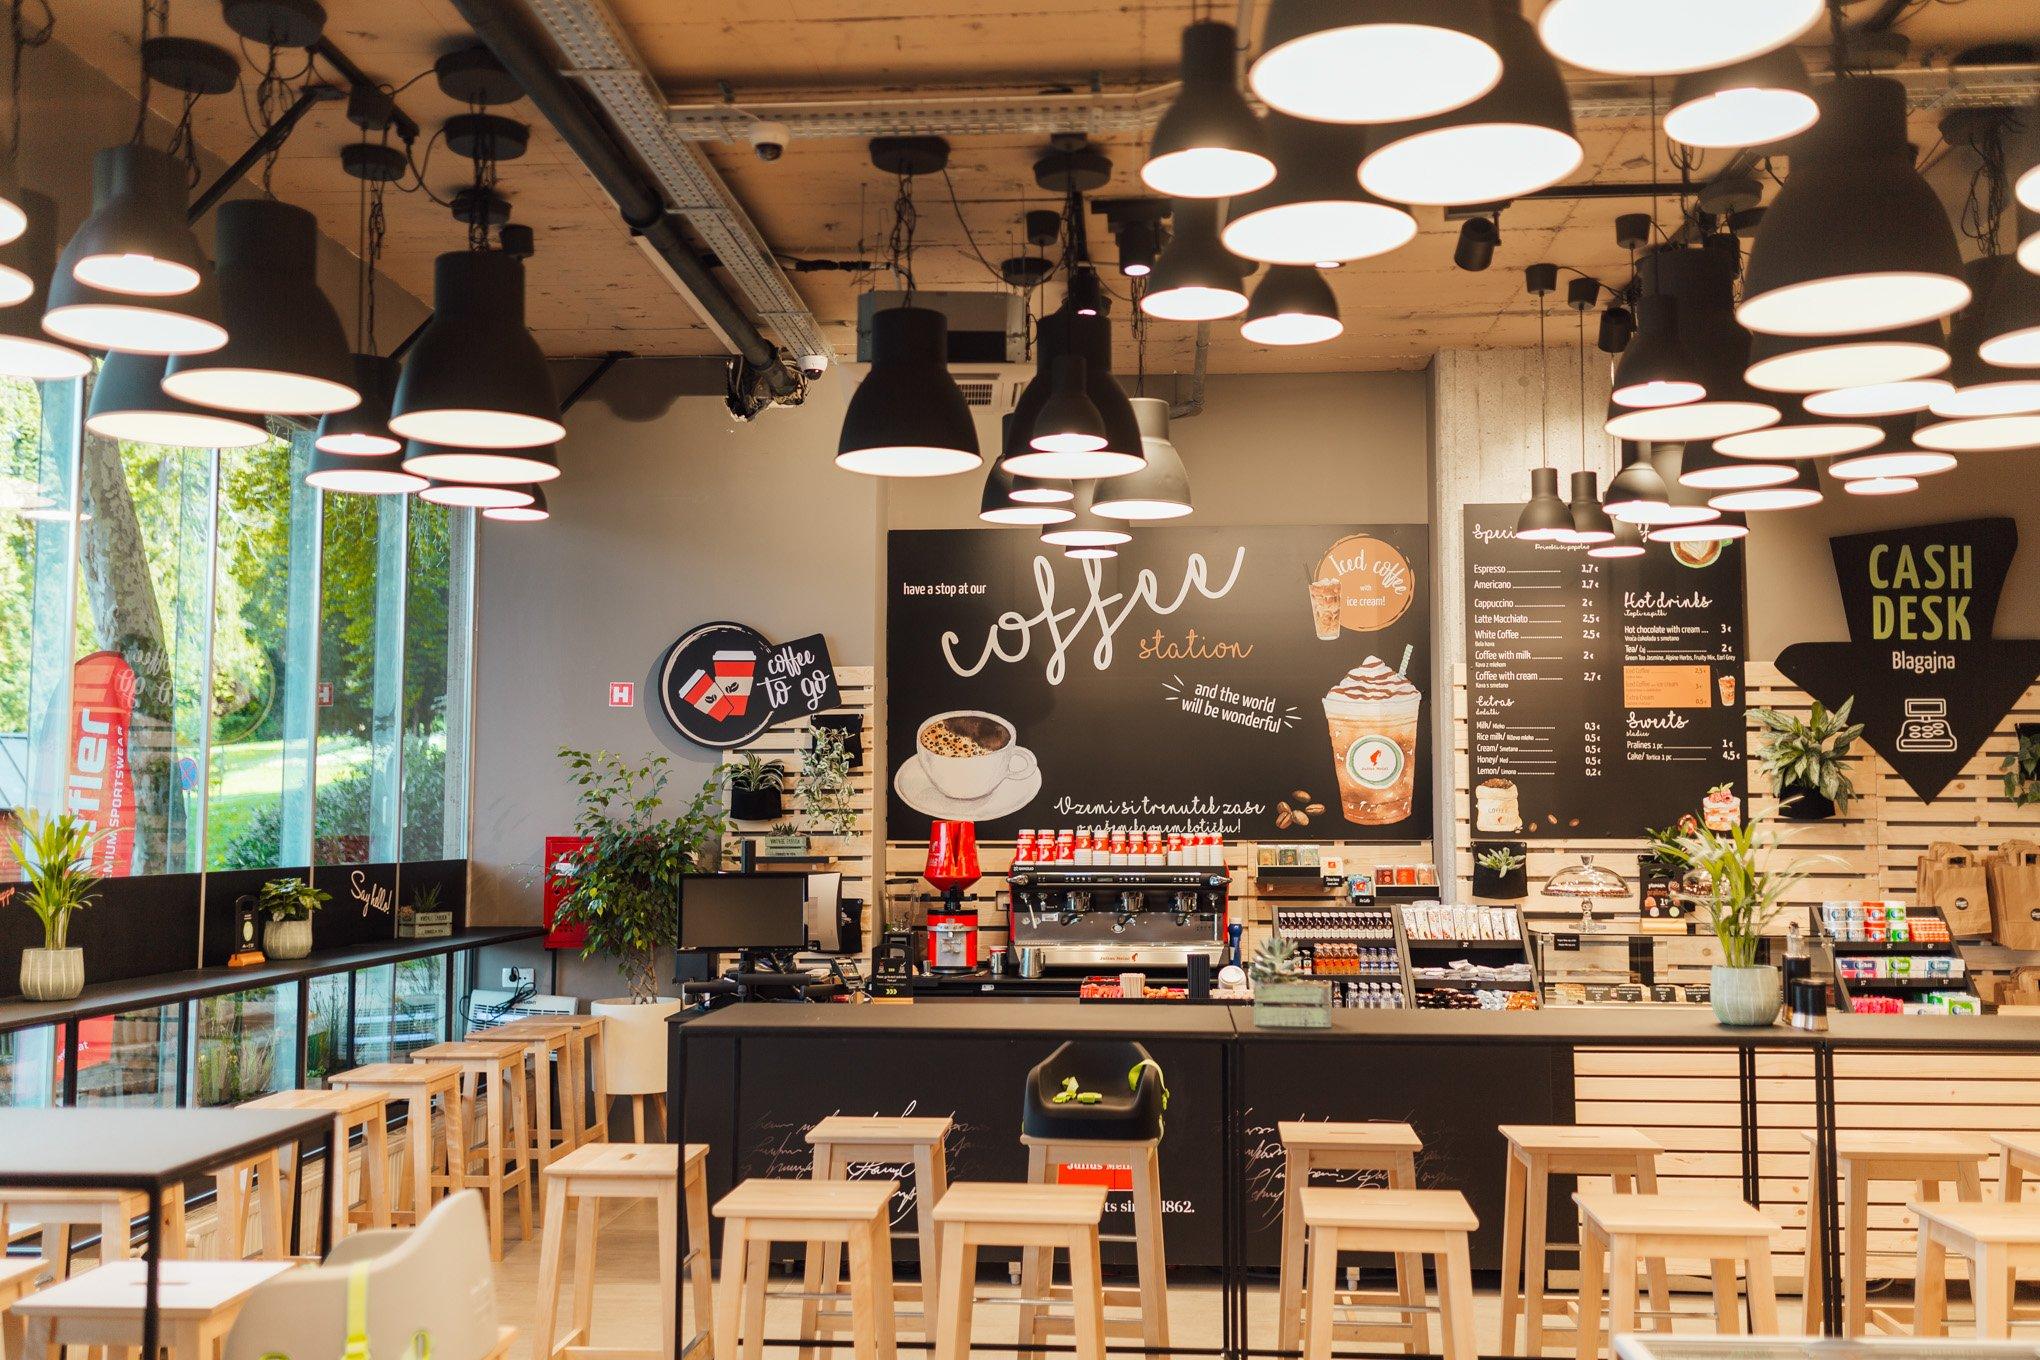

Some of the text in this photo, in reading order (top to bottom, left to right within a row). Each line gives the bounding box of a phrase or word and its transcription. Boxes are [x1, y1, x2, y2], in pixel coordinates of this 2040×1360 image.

[1329, 549, 1407, 595] Iced coffee
[1473, 564, 1506, 575] Espresso
[1868, 544, 1973, 590] CASH
[903, 582, 987, 597] have a stop at our
[1473, 580, 1511, 589] Americano
[1346, 595, 1386, 606] ice cream!
[1474, 599, 1514, 609] Cappuccino
[1582, 598, 1588, 606] 2
[1624, 591, 1713, 608] Hot drinks
[941, 546, 1246, 686] coffee
[1474, 614, 1493, 623] Latte
[1493, 614, 1528, 623] Macchiato
[1582, 614, 1595, 624] 2,5
[1872, 595, 1971, 641] DESK
[1474, 630, 1496, 639] White
[1496, 630, 1519, 639] Coffee
[1582, 630, 1595, 640] 2,5
[1624, 625, 1636, 633] Hot
[1636, 625, 1666, 633] chocolate
[1666, 625, 1680, 633] with
[1681, 626, 1700, 634] cream
[1720, 624, 1727, 634] 3
[1138, 628, 1254, 660] station
[1721, 644, 1728, 653] 2
[767, 646, 815, 677] coffee
[1475, 650, 1497, 660] Coffee
[1498, 650, 1515, 659] with
[1515, 650, 1531, 659] milk
[1583, 651, 1589, 659] 2
[1892, 651, 1956, 674] Blagajna
[1475, 671, 1497, 681] Coffee
[1498, 671, 1515, 680] with
[1516, 672, 1538, 680] cream
[1583, 672, 1596, 682] 2,7
[757, 669, 830, 711] to go
[1195, 684, 1277, 714] and the world
[1475, 695, 1515, 707] Extras
[1181, 698, 1282, 734] will be wonderful
[1626, 710, 1689, 728] Sweets
[1476, 732, 1489, 740] Rice
[1626, 740, 1652, 749] Pralines
[1722, 739, 1728, 748] 1
[1722, 751, 1735, 760] 4,5
[110, 726, 124, 828] SPORTSWEAR
[1054, 796, 1266, 816] Vzemi si trenutek zase
[351, 870, 372, 917] Say
[1161, 1200, 1195, 1213] 1862.
